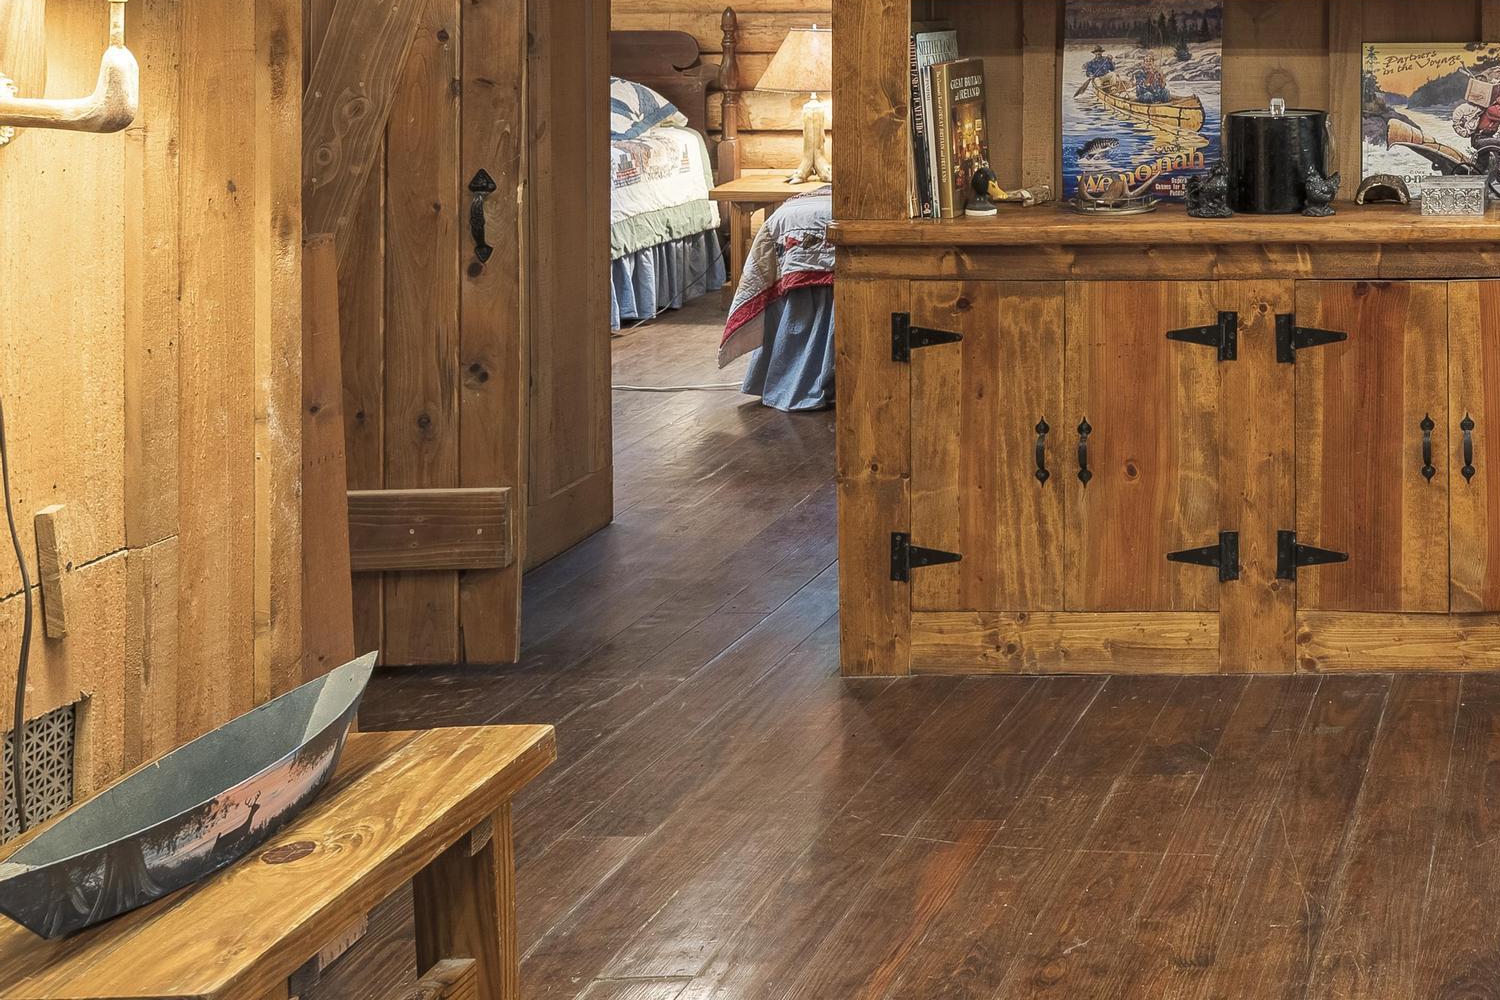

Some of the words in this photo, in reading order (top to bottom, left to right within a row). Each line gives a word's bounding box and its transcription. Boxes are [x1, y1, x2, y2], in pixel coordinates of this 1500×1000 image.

[1383, 50, 1437, 68] Partners
[1397, 63, 1413, 72] the
[1415, 55, 1461, 68] Voyage
[950, 79, 964, 90] GREAT
[964, 75, 983, 84] BRITAIN
